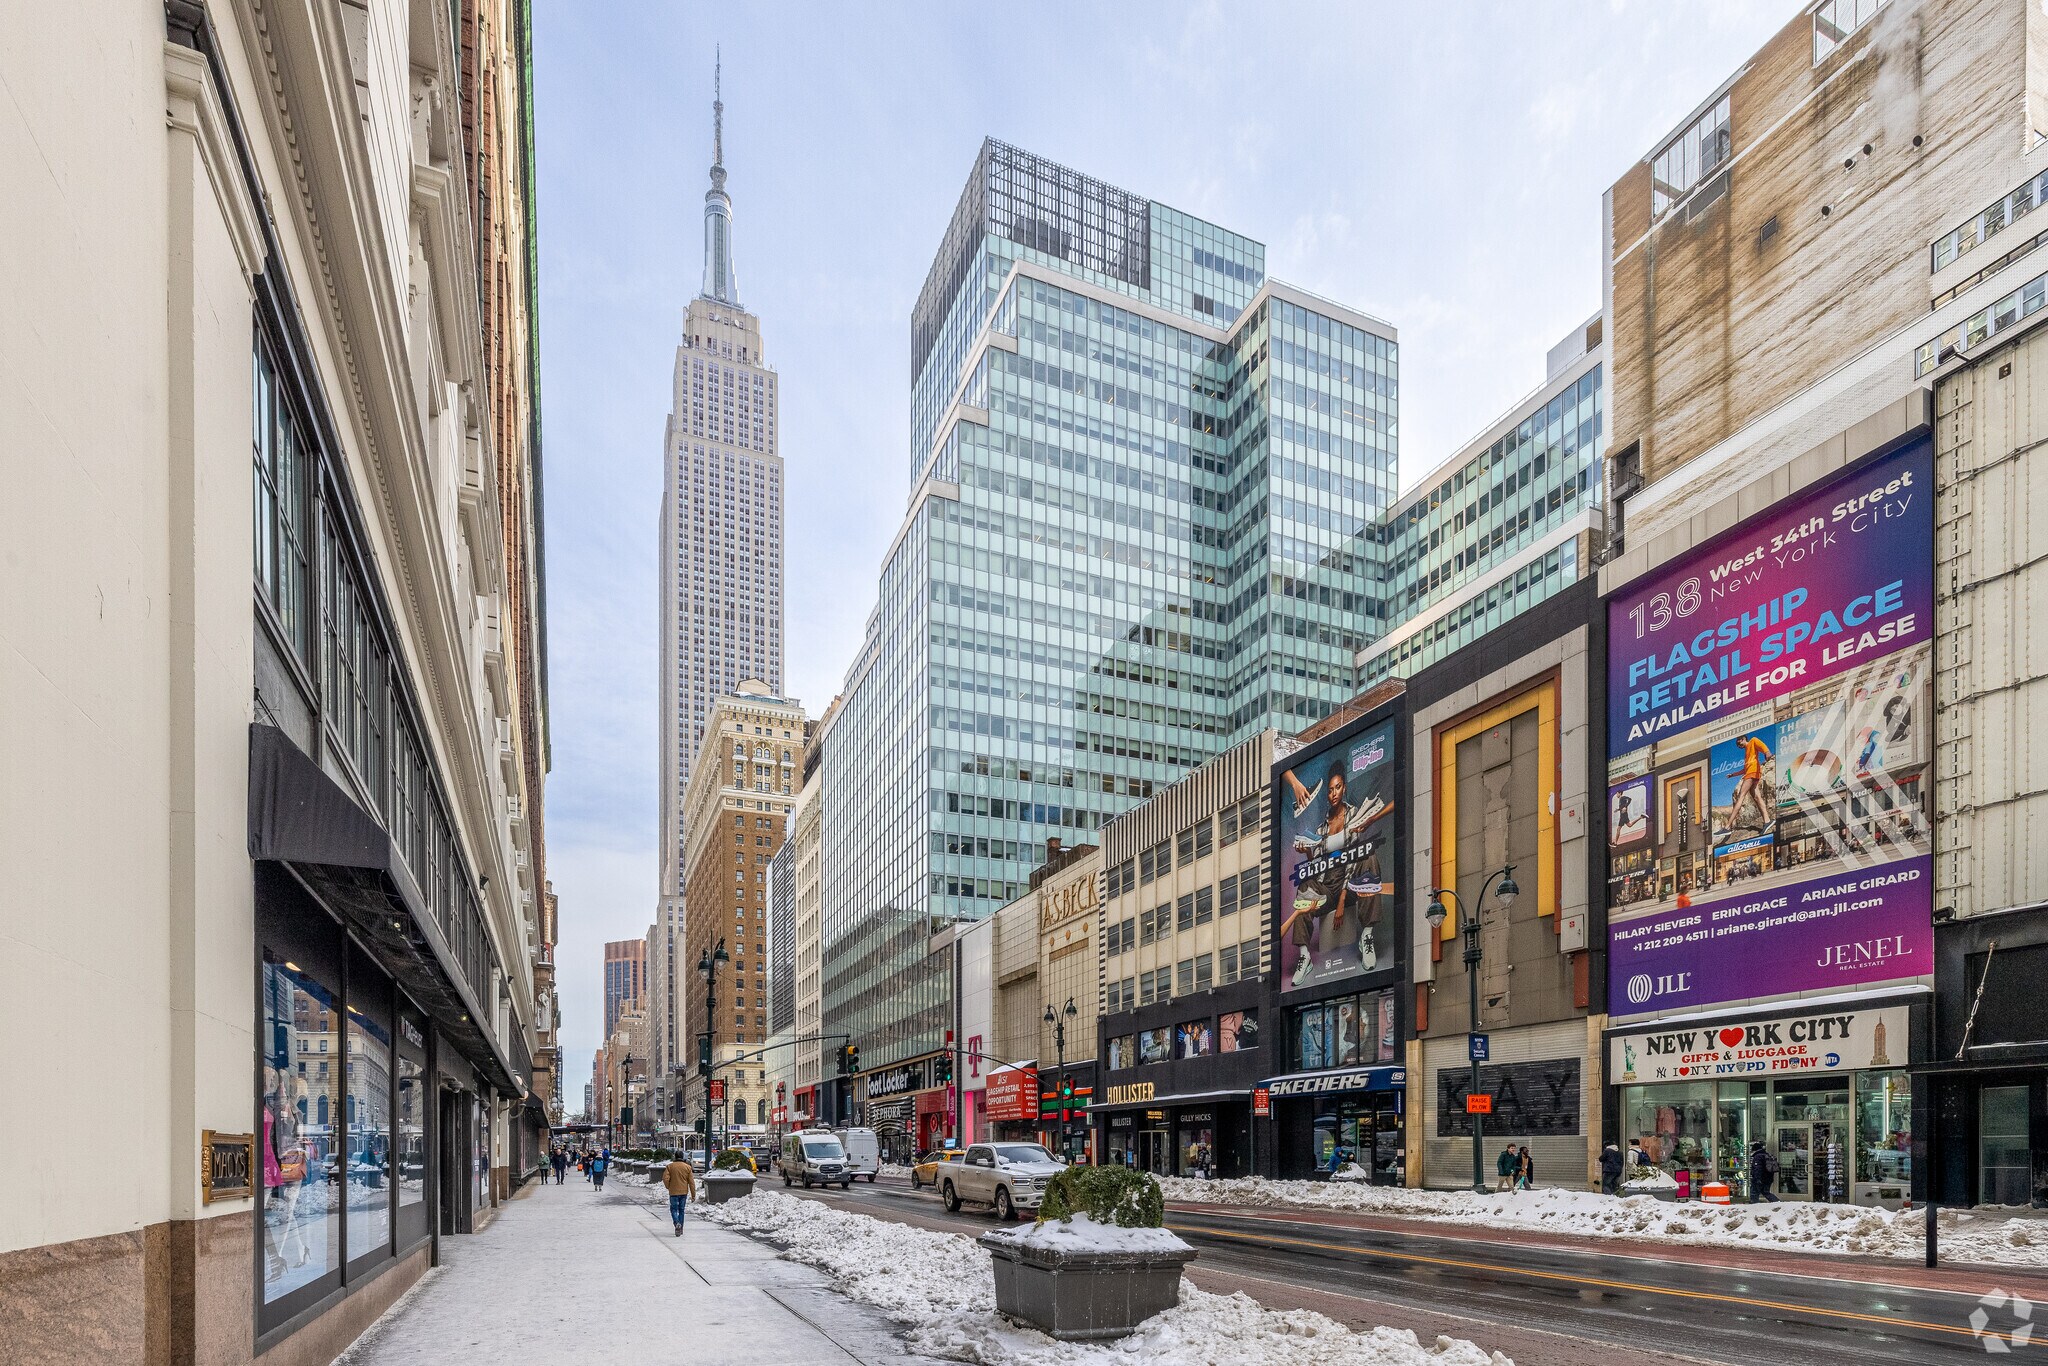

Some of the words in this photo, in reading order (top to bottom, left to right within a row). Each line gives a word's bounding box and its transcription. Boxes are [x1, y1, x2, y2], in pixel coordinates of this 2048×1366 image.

[1709, 545, 1764, 582] West
[1770, 517, 1824, 553] 34th
[1832, 470, 1913, 523] Street
[1711, 567, 1763, 603] New
[1774, 533, 1836, 570] York
[1851, 493, 1912, 533] City
[1630, 577, 1701, 639] 138
[1629, 587, 1808, 687] FLAGSHIP
[1629, 651, 1750, 718] RETAIL
[1760, 580, 1903, 662] SPACE
[1627, 677, 1750, 741] AVAILABLE
[1756, 659, 1807, 692] FOR
[1822, 613, 1915, 666] LEASE
[1298, 842, 1373, 880] GLIDE-STEP
[1614, 926, 1652, 941] HILARY
[1654, 915, 1701, 933] SIEVERS
[1712, 907, 1740, 921] ERIN
[1743, 897, 1787, 914] GRACE
[1801, 883, 1857, 902] ARIANE
[1860, 870, 1920, 890] GIRARD
[1633, 942, 1643, 951] +1
[1644, 939, 1661, 950] 212
[1663, 935, 1683, 947] 209
[1685, 930, 1709, 942] 4511
[1716, 897, 1883, 937] ariane.girard@am.jll.com
[1817, 935, 1912, 967] JENEL
[1859, 960, 1885, 969] ESTATE
[1646, 1031, 1698, 1056] NEW
[1789, 1015, 1854, 1042] CITY
[1681, 1052, 1719, 1064] GIFTS
[1723, 1050, 1733, 1061] &
[1737, 1045, 1808, 1060] LUGGAGE
[968, 1034, 982, 1078] T
[867, 1074, 882, 1096] Foot
[882, 1069, 908, 1094] Locker
[1107, 1081, 1155, 1105] HOLLISTER
[1269, 1073, 1369, 1096] SKECHERS
[873, 1105, 901, 1121] SEPHORA
[1180, 1114, 1195, 1122] GILLY
[1195, 1113, 1212, 1121] HICKS
[212, 1150, 246, 1179] MACY'S
